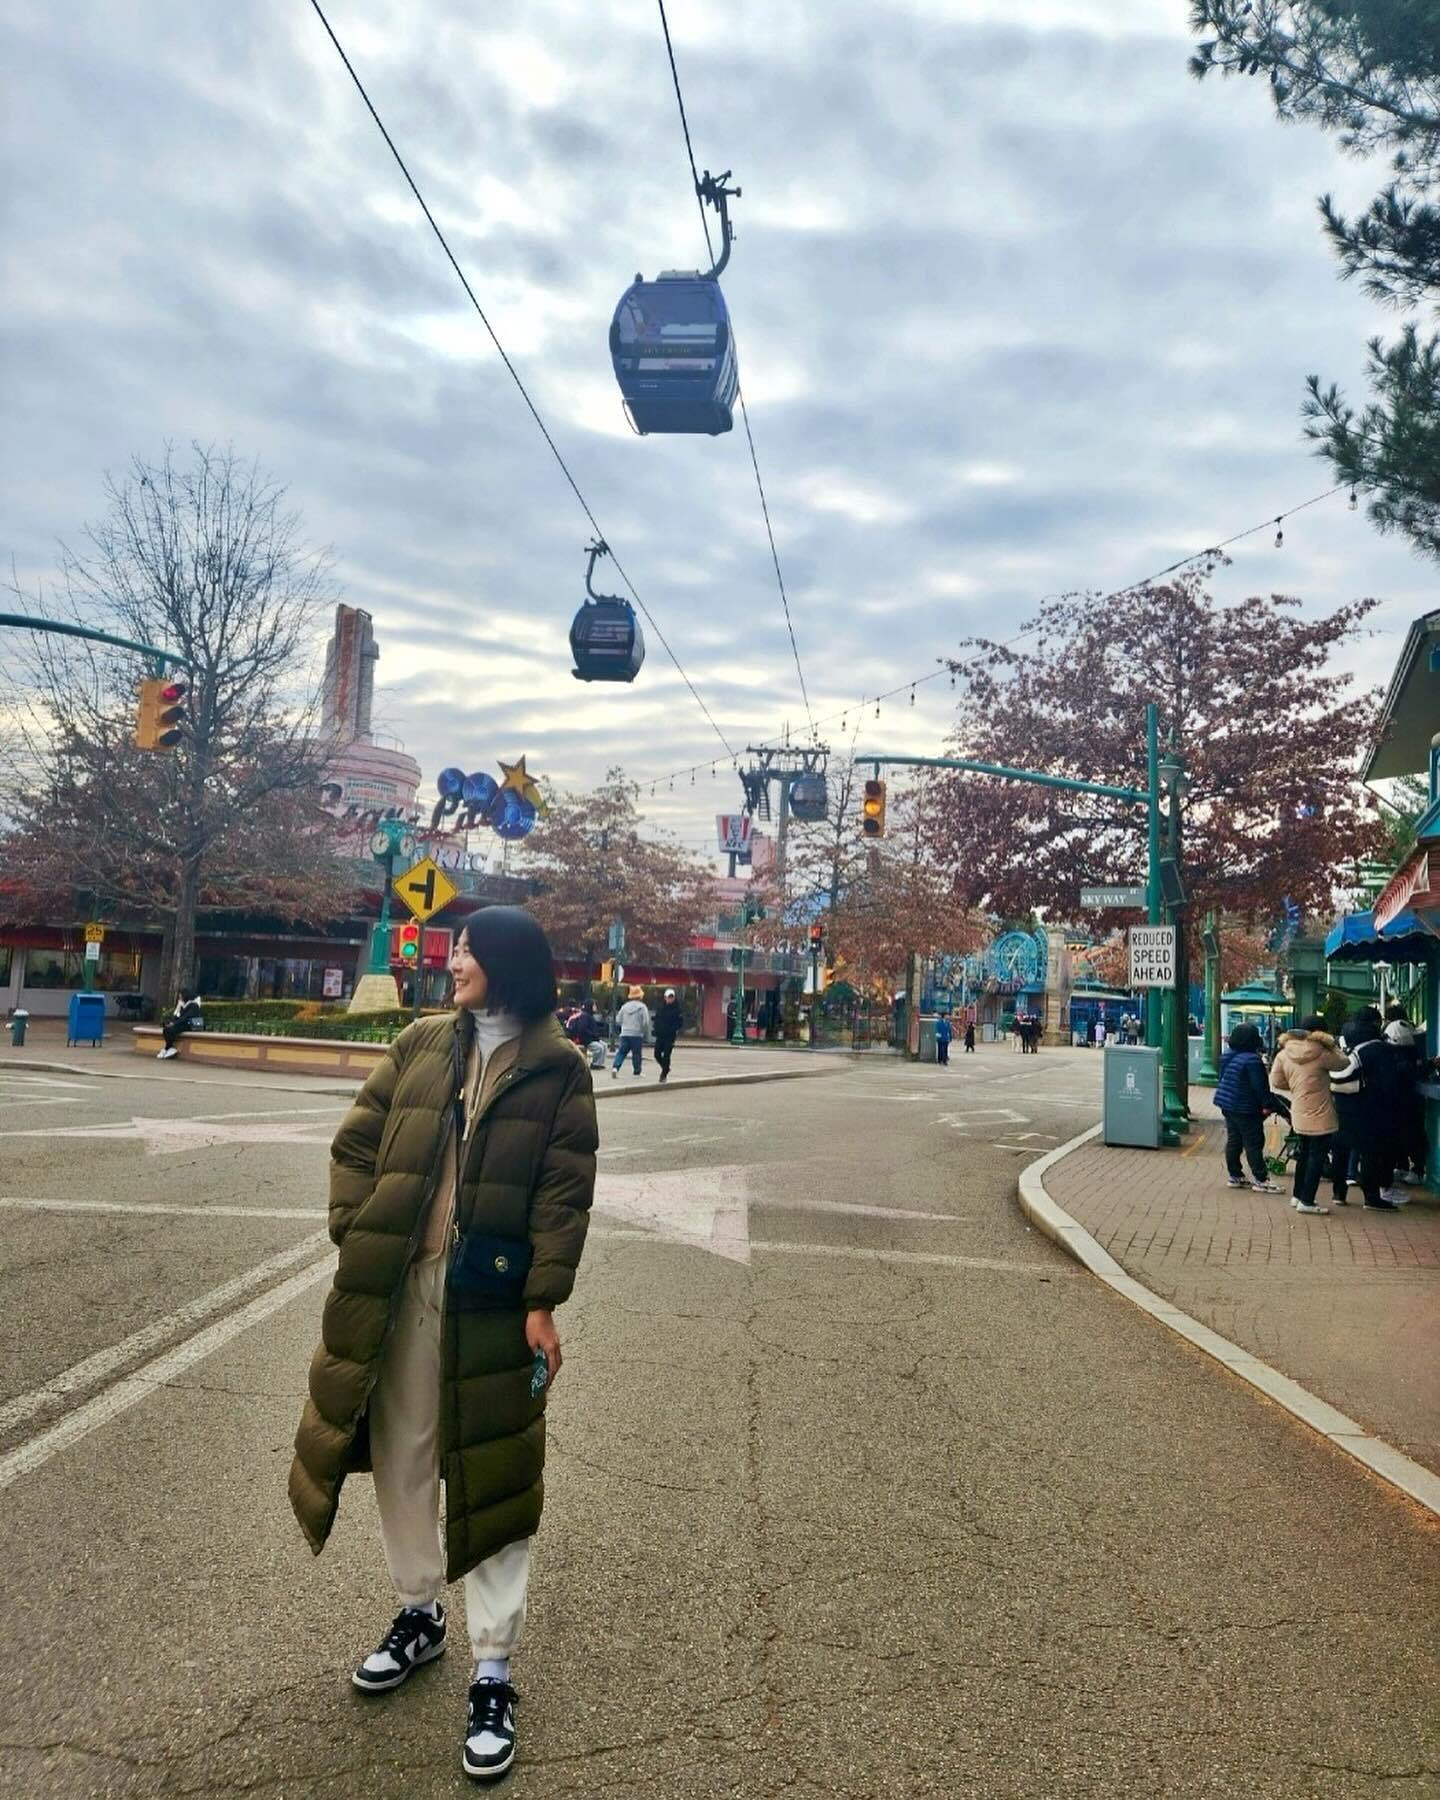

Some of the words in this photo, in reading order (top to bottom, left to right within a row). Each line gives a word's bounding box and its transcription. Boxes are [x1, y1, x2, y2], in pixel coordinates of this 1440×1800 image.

[1132, 932, 1172, 946] REDUCED
[1133, 949, 1171, 963] SPEED
[1132, 967, 1172, 980] AHEAD
